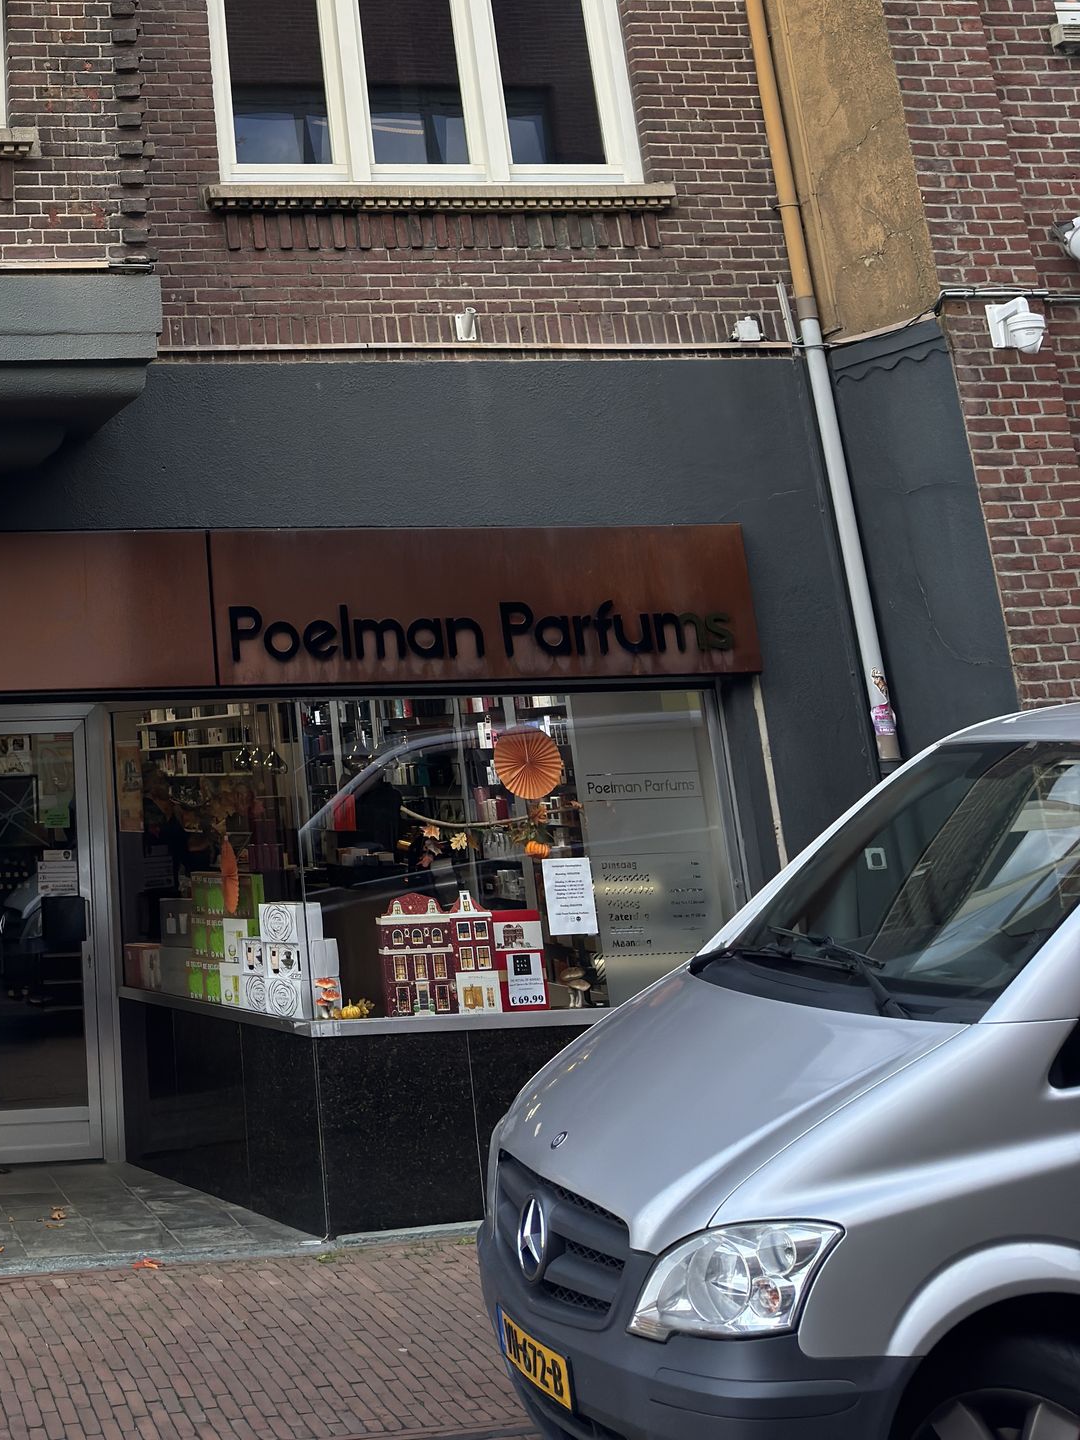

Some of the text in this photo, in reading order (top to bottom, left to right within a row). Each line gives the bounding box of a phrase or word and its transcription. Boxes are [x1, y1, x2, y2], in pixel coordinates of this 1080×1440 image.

[228, 599, 735, 662] Poelman Parfums
[587, 779, 695, 795] Poelman Parfums
[519, 994, 544, 1004] 69.99
